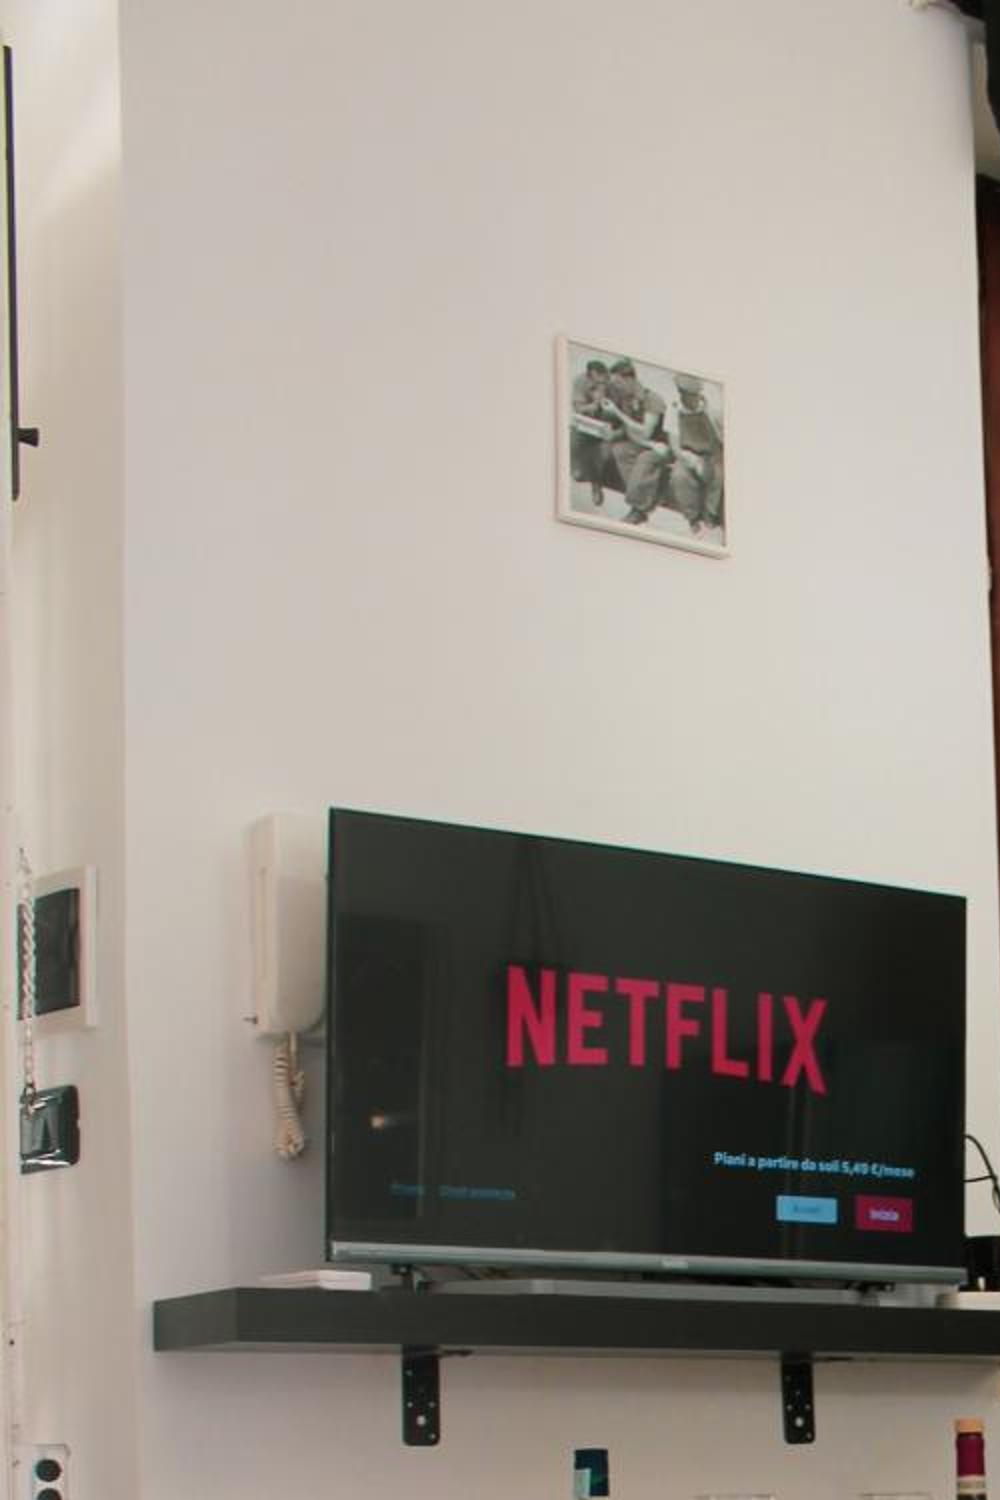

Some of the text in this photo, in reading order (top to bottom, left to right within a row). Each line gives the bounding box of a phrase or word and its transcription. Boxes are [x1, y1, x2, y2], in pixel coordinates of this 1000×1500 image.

[506, 963, 828, 1097] NETFLIX
[713, 1151, 747, 1166] Piani
[750, 1156, 756, 1166] a
[757, 1155, 799, 1171] partire
[801, 1157, 817, 1171] da
